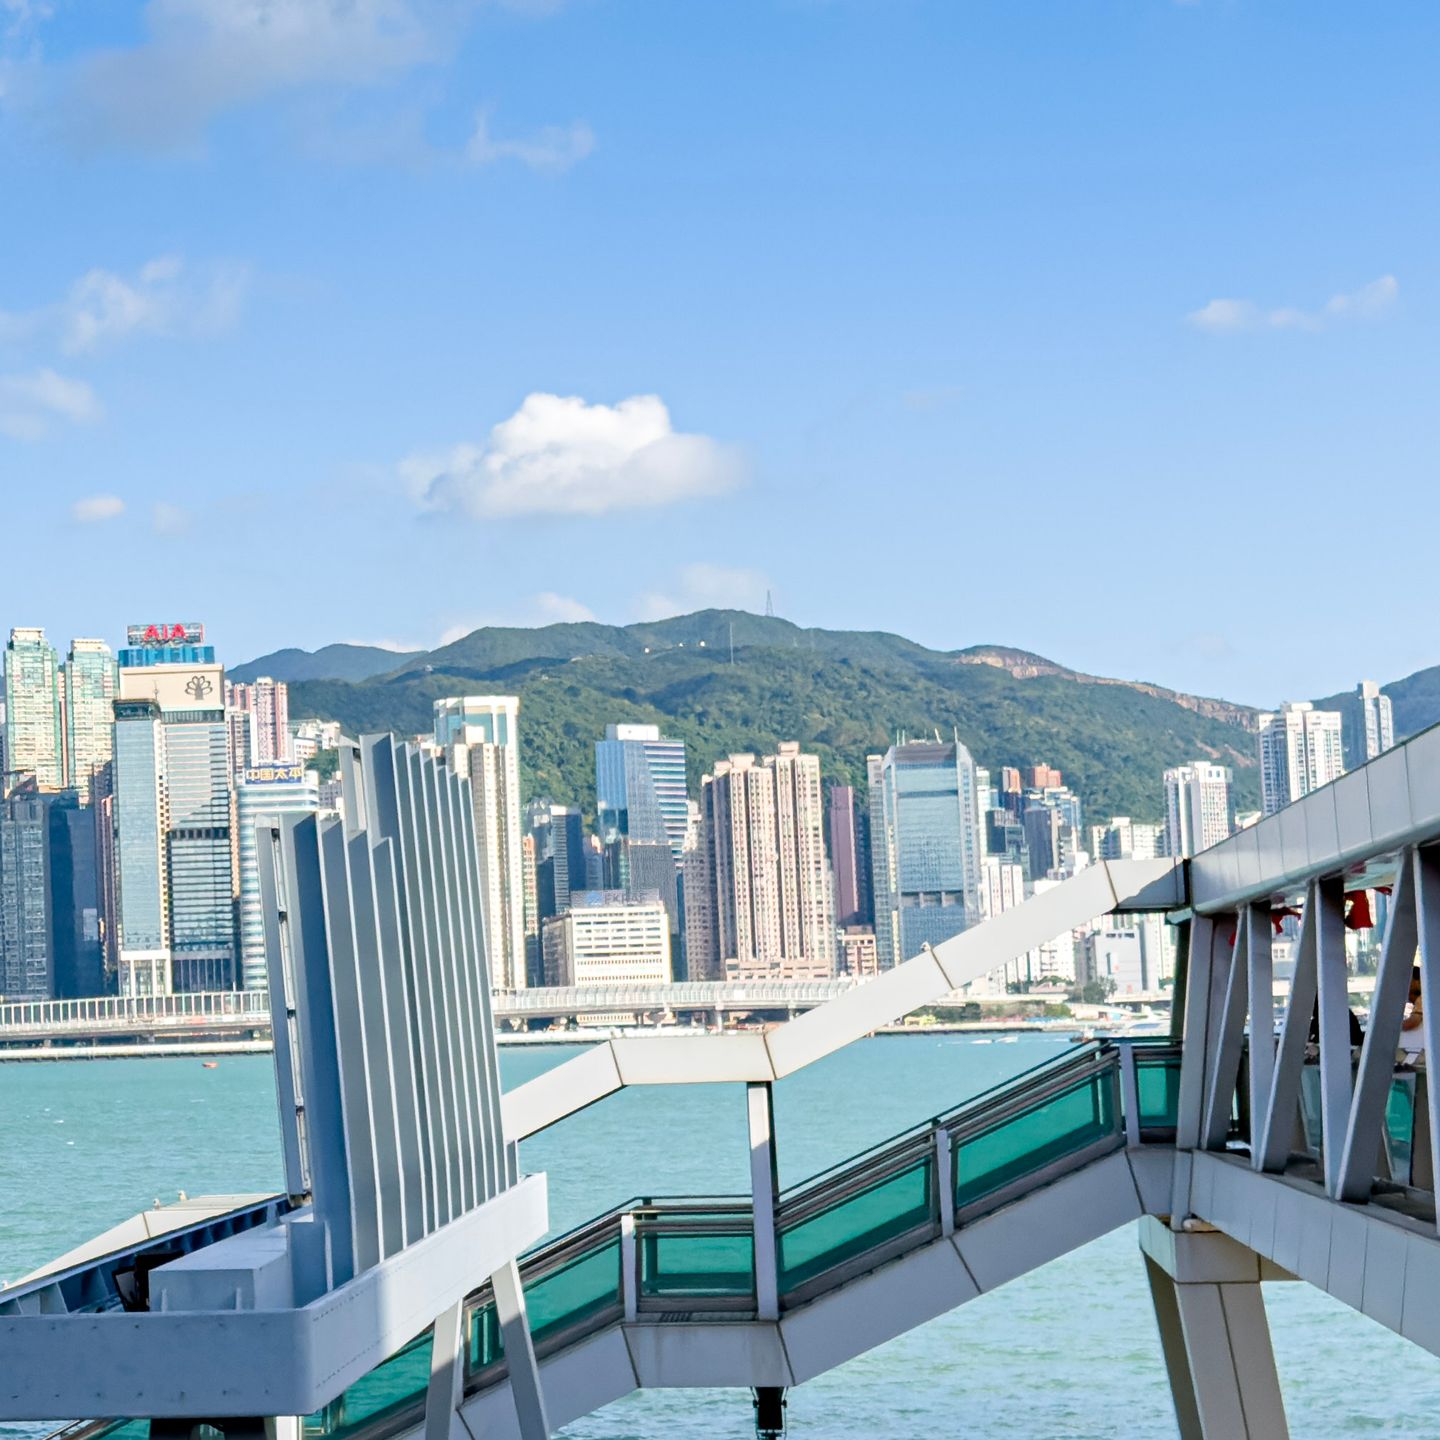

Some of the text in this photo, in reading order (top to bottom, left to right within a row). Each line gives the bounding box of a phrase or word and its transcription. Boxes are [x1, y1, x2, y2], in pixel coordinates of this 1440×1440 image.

[143, 624, 187, 641] AIA
[247, 768, 302, 781] 中国太平
